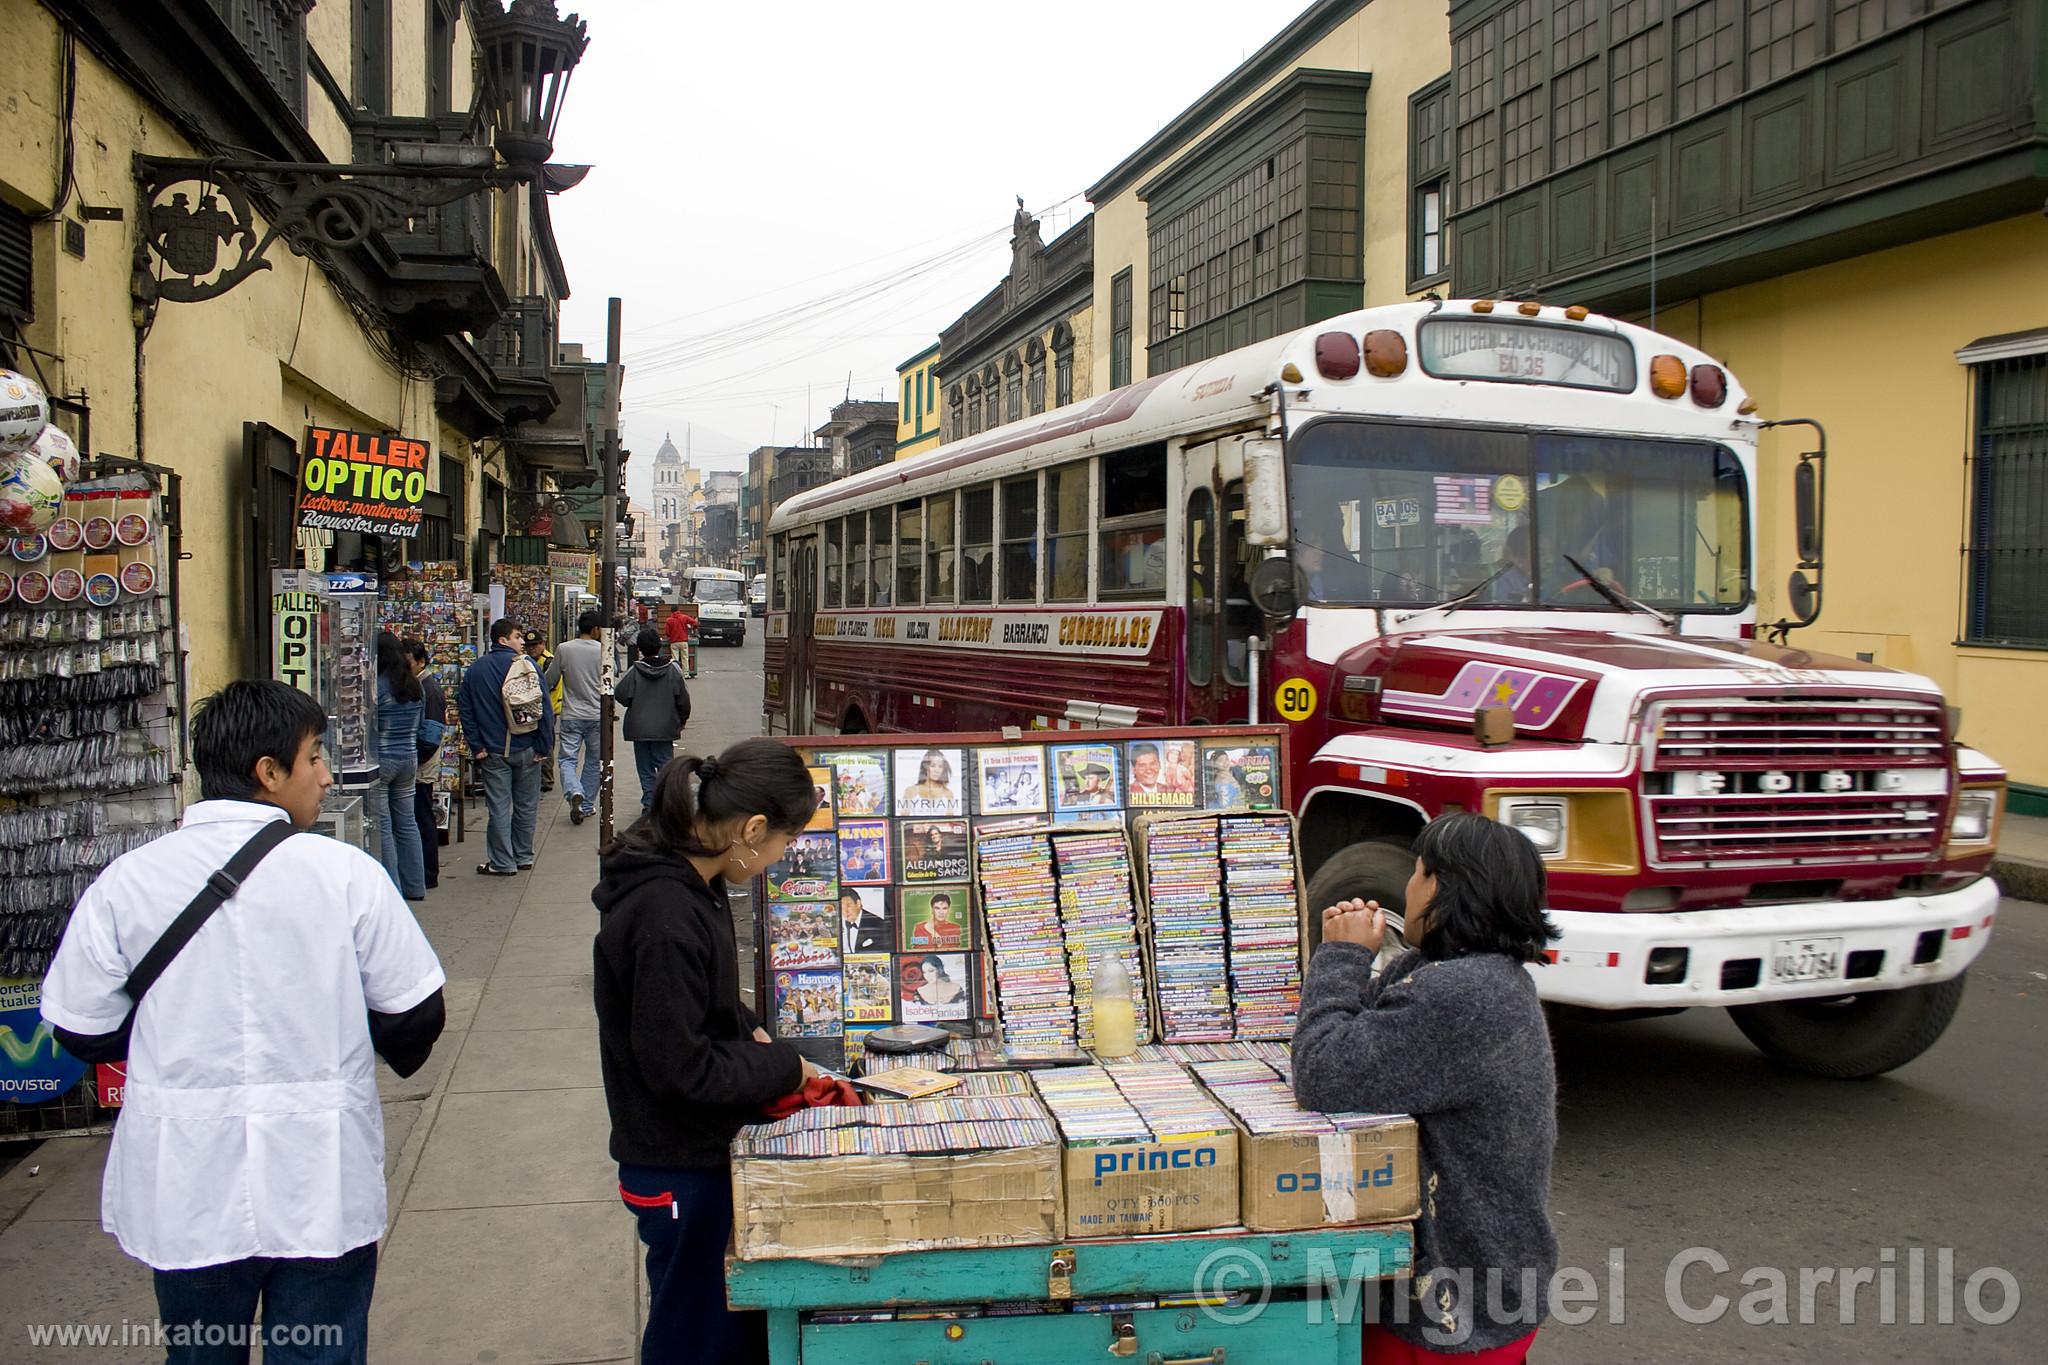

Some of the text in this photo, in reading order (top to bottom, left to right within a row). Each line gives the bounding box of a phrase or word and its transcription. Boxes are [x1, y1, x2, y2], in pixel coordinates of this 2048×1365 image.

[312, 429, 427, 470] TALLER
[304, 457, 425, 503] OPTICO
[302, 509, 420, 538] Repuestos en Gral
[273, 592, 320, 613] TALLER
[1003, 623, 1049, 645] BARRANCO
[1058, 615, 1152, 649] CHORRILLOS
[1284, 687, 1309, 712] 90
[1696, 770, 1904, 795] FORD
[897, 799, 960, 809] MYRIAM
[1131, 791, 1194, 805] HILDEMARO
[905, 858, 968, 871] ALEJANDRO
[937, 867, 968, 877] SANZ
[858, 1008, 886, 1019] DAN
[1094, 1146, 1217, 1187] princo
[1175, 1194, 1200, 1206] PCS
[1080, 1212, 1153, 1225] MADE IN TAIWAN
